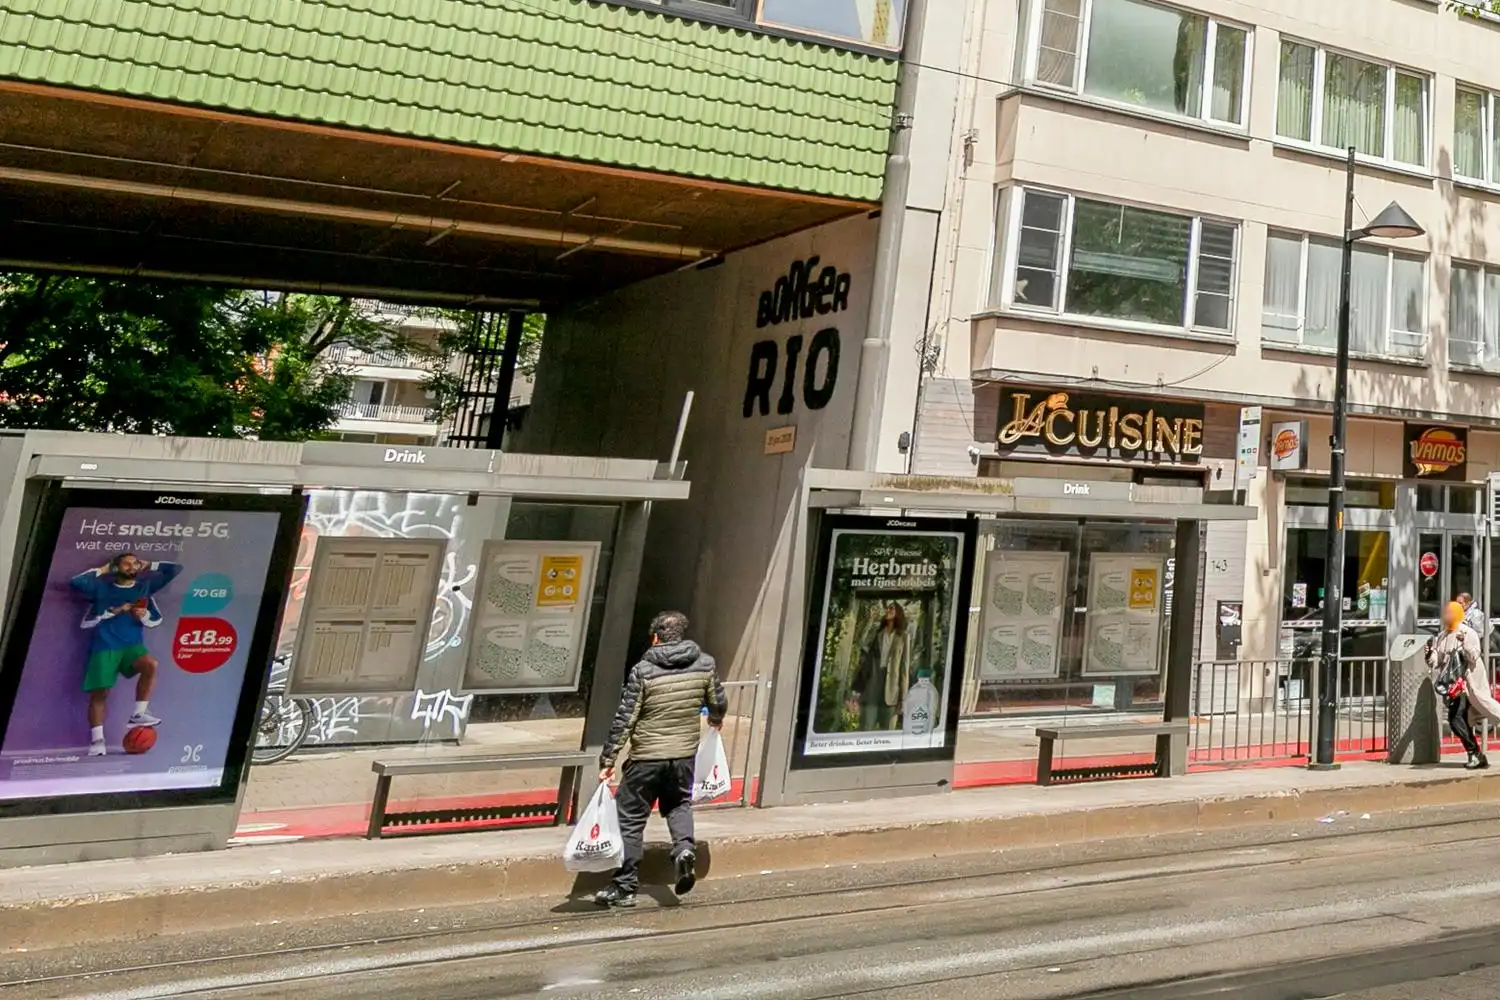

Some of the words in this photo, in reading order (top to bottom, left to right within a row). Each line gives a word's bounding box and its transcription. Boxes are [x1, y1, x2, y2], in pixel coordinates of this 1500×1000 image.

[743, 327, 841, 418] RIO
[384, 448, 426, 464] Drink
[1410, 440, 1466, 463] VAMOS
[1063, 483, 1090, 495] Drink
[154, 496, 204, 506] JCDecaux
[79, 519, 118, 536] Het
[117, 520, 193, 538] snelste
[75, 541, 101, 551] wat
[104, 541, 131, 552] een
[134, 540, 184, 553] verschil
[851, 557, 938, 576] Herbruis
[850, 578, 871, 587] met
[873, 576, 897, 588] fijne
[192, 588, 208, 598] 70
[209, 588, 228, 598] GB
[179, 629, 233, 646] €18.99
[911, 712, 928, 721] SPA
[575, 839, 612, 851] Karim
